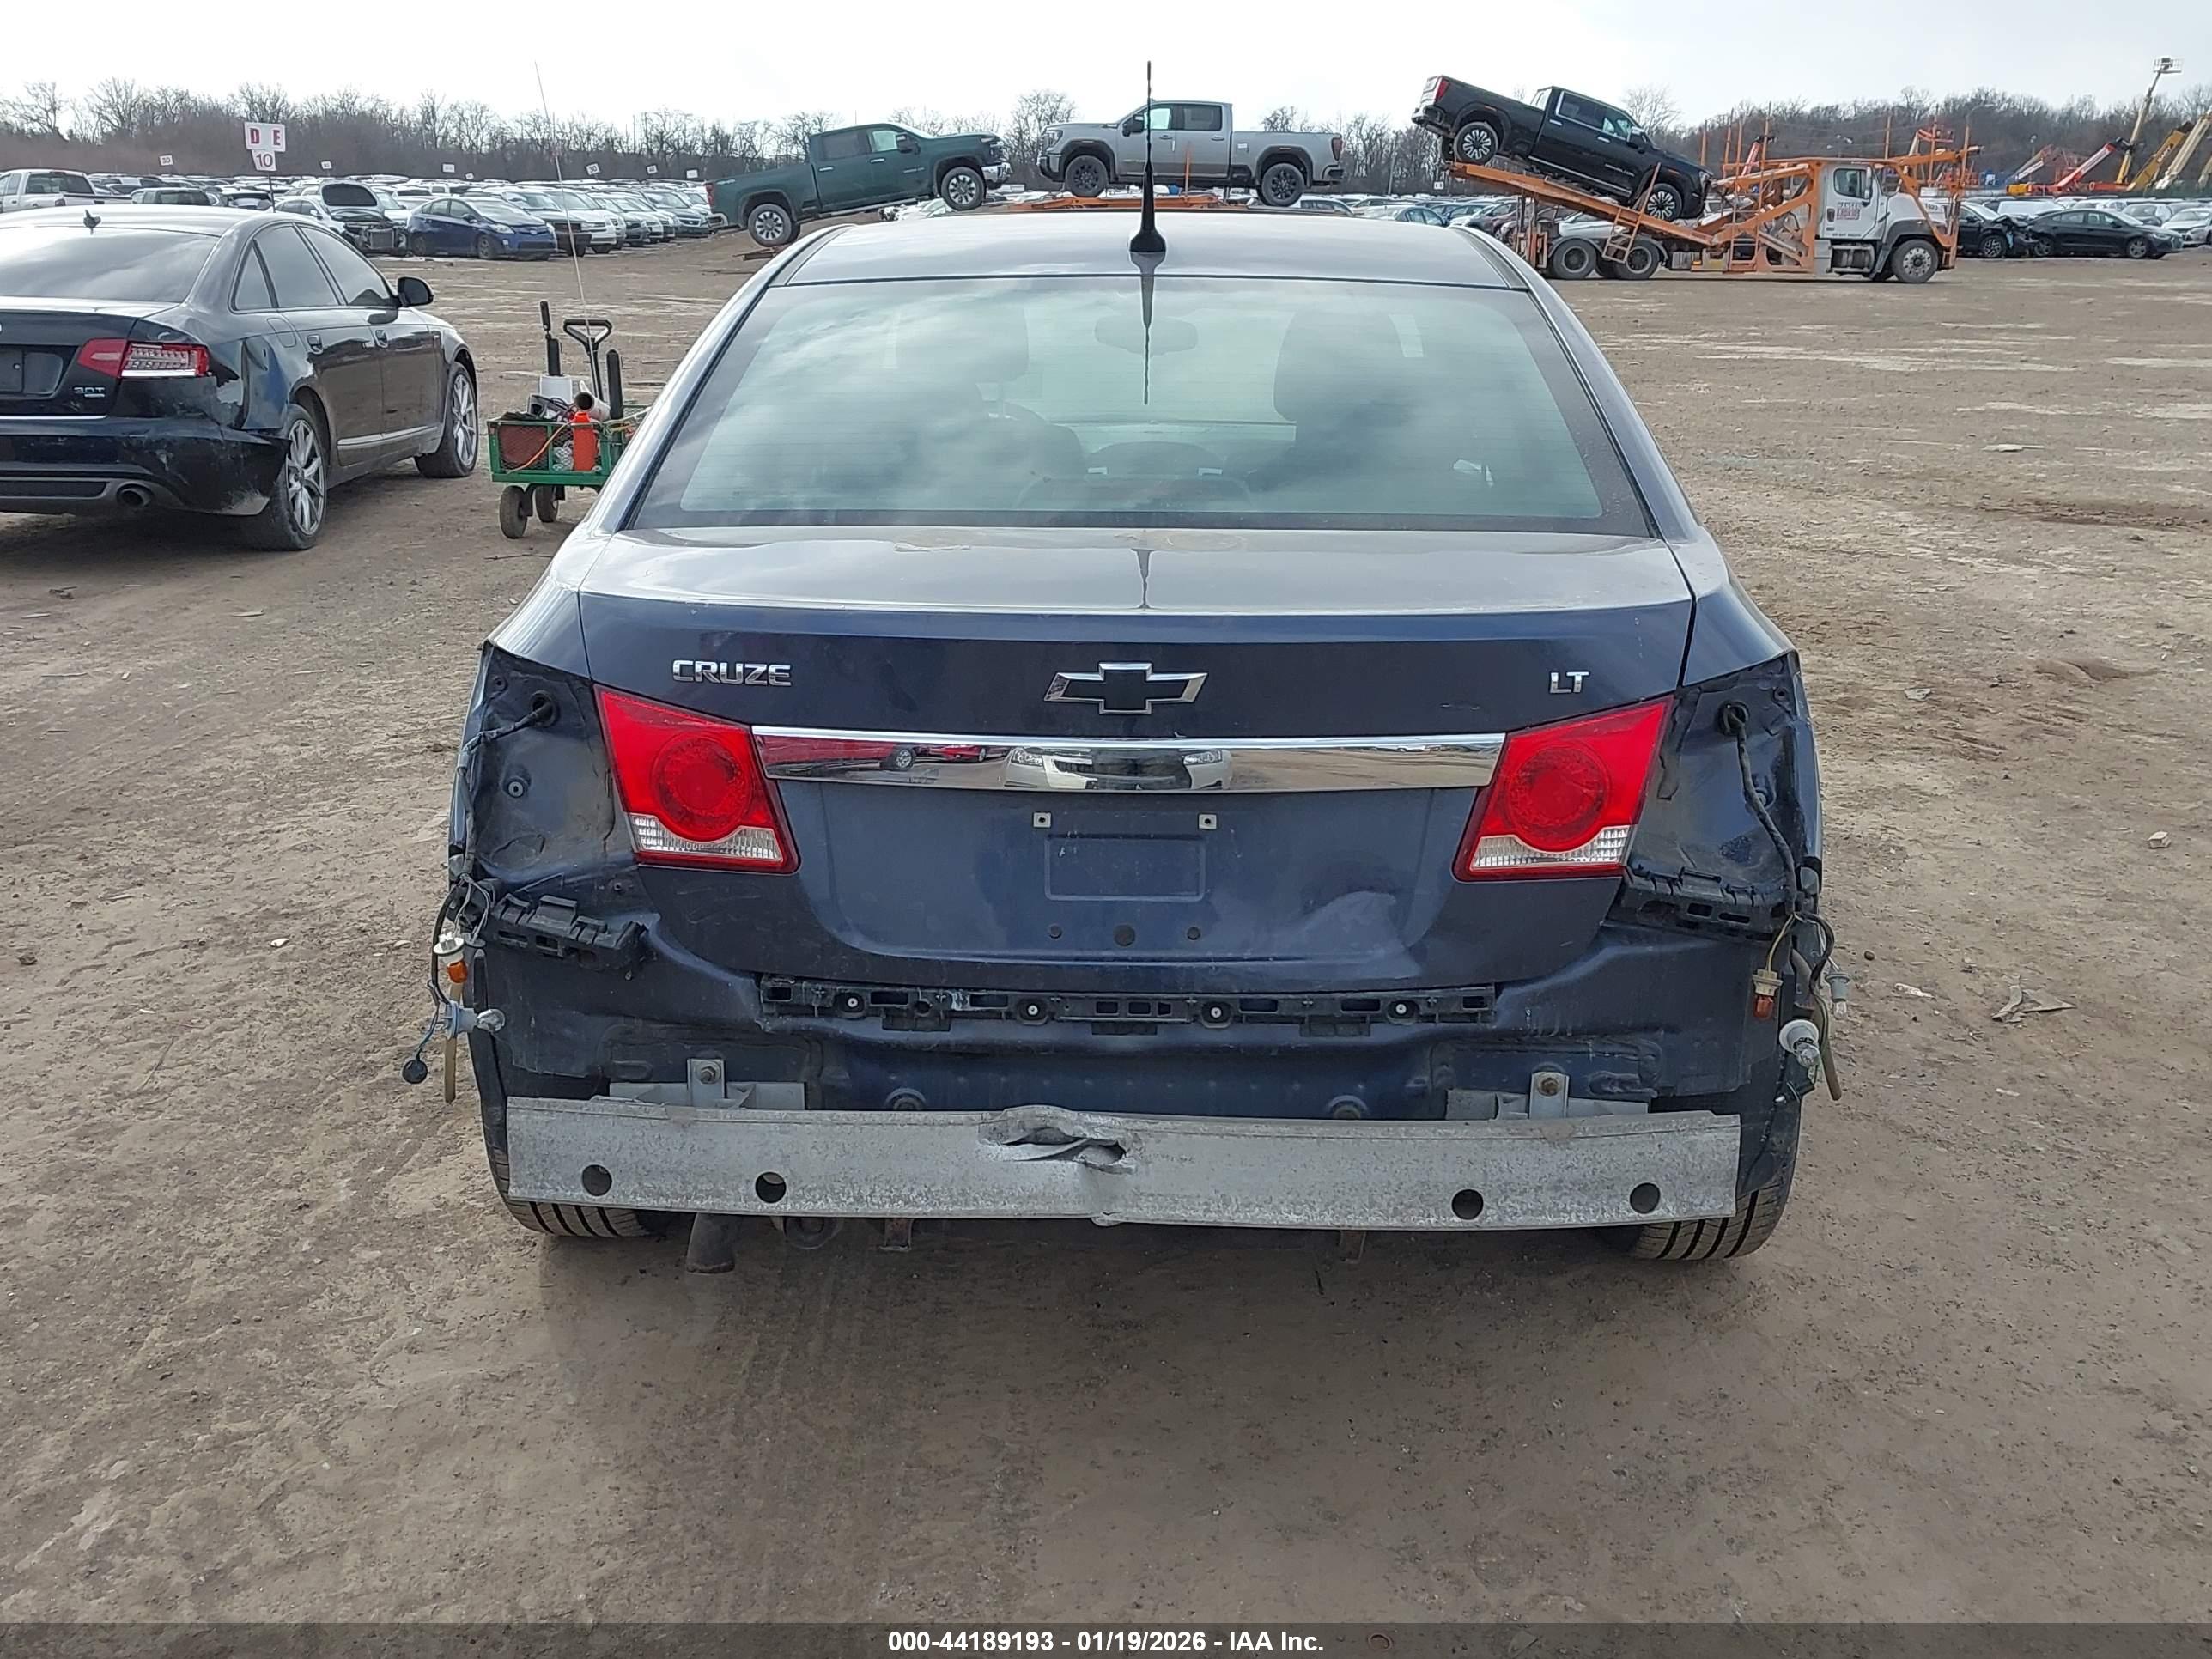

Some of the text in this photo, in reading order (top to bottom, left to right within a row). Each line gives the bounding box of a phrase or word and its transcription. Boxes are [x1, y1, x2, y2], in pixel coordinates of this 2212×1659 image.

[250, 128, 281, 146] D E
[256, 154, 273, 167] 10
[672, 659, 792, 686] CRUZE
[1549, 672, 1589, 694] LT
